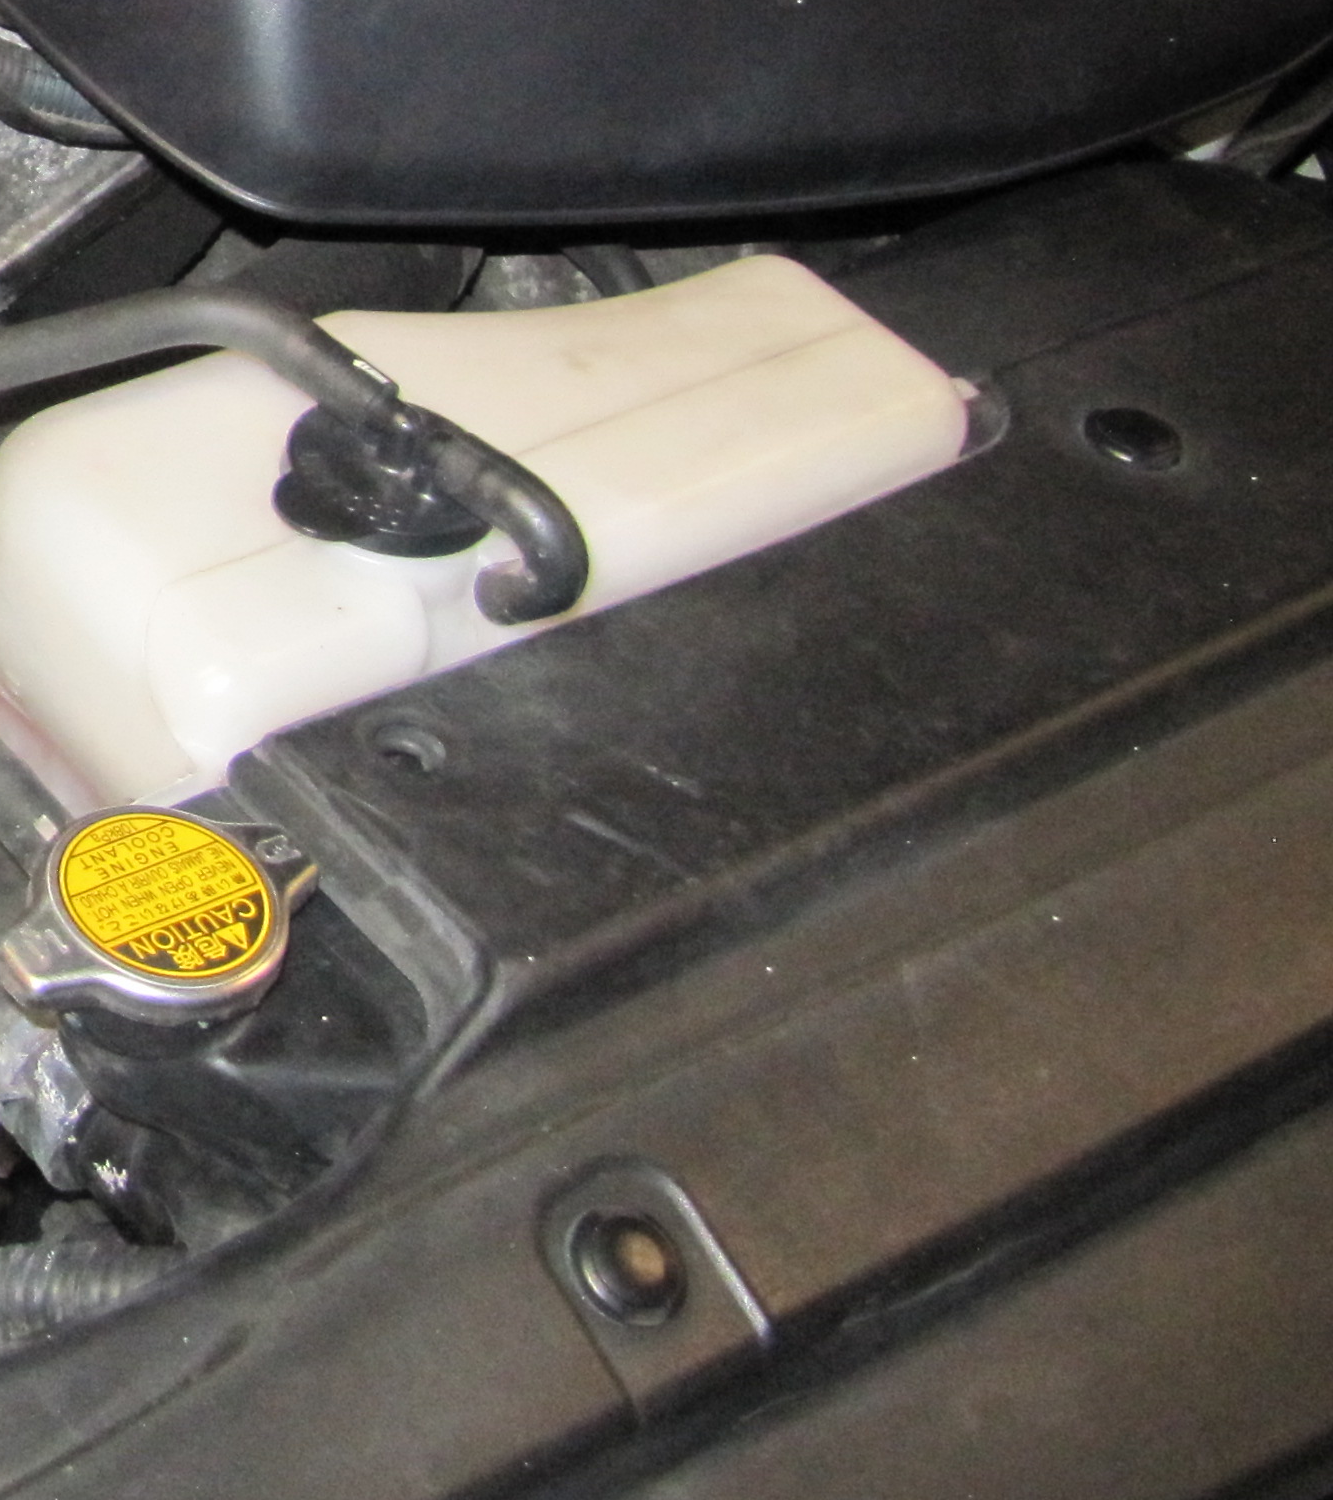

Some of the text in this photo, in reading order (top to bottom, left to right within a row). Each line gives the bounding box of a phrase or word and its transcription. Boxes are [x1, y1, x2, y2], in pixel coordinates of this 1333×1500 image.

[82, 826, 175, 869] COOLANT
[94, 841, 180, 879] ENGINE
[157, 874, 193, 894] OPEN
[195, 859, 237, 880] NEVER
[120, 889, 157, 908] WHEN
[128, 898, 257, 960] CAUTION
[167, 932, 229, 969] 危険
